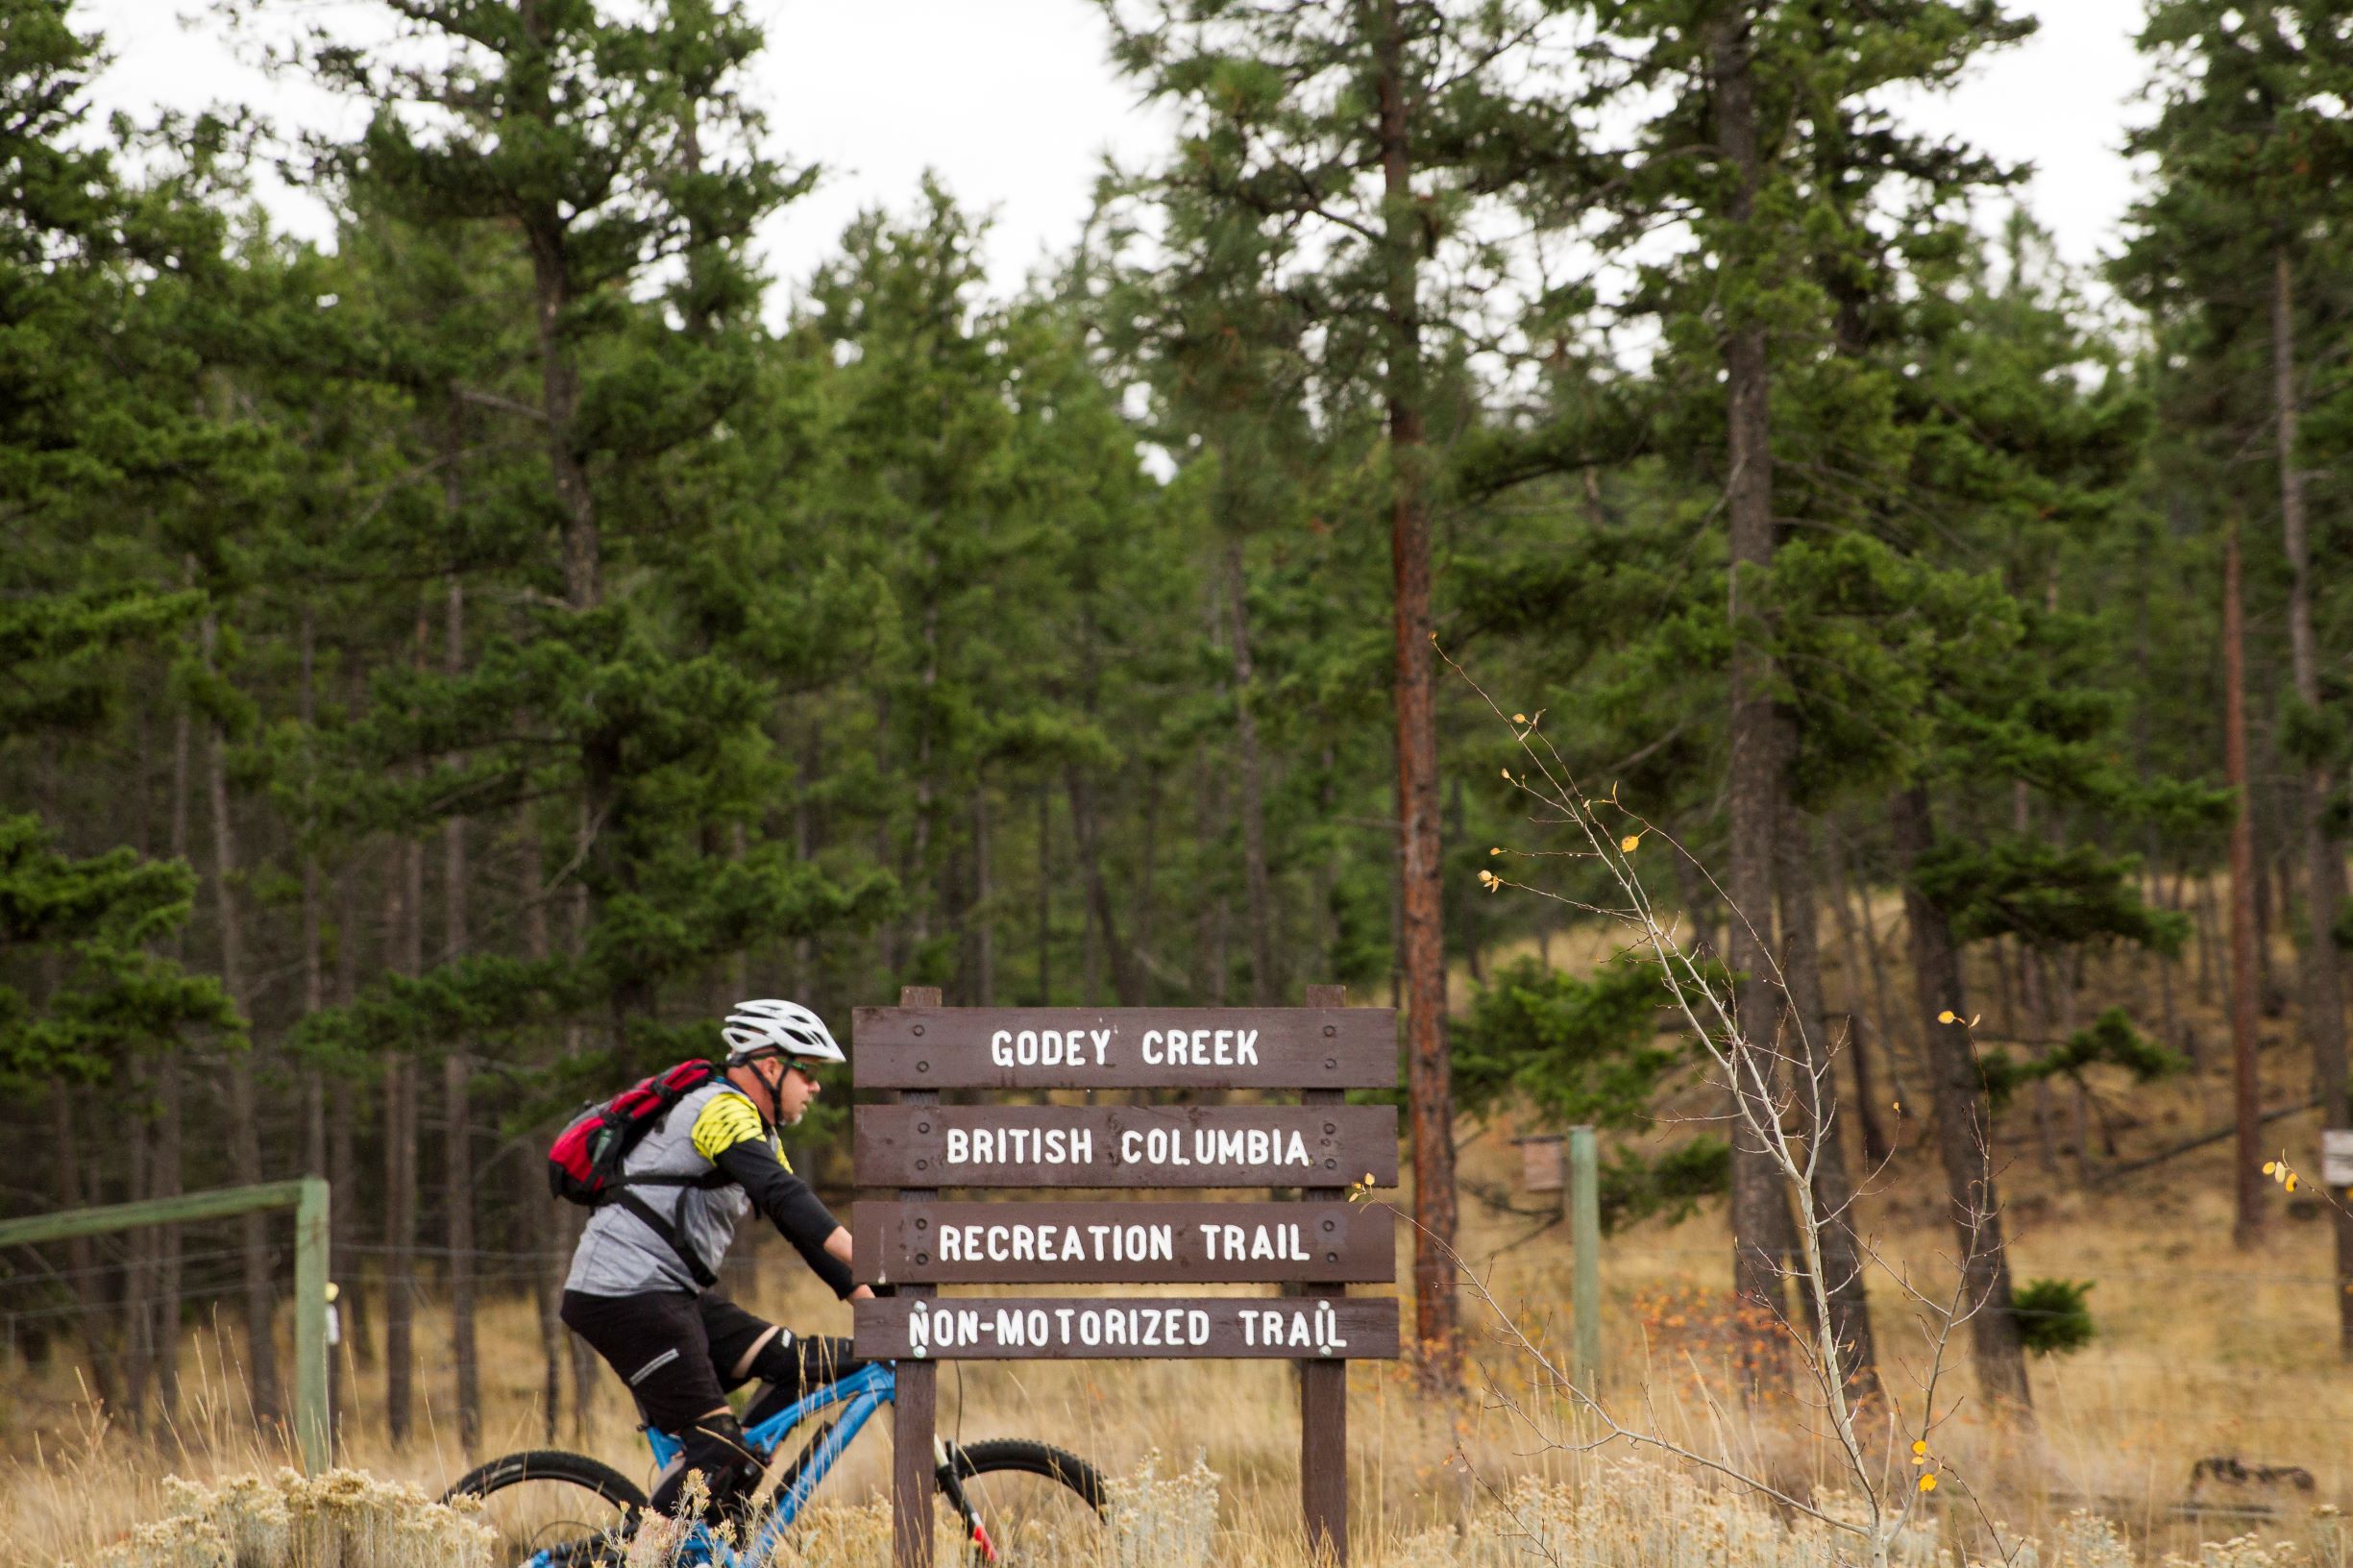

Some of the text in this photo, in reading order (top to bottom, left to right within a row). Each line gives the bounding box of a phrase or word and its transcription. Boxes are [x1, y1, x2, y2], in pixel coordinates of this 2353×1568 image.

[991, 1028, 1259, 1068] GODEY CREEK
[946, 1127, 1310, 1166] BRITISH COLUMBIA
[939, 1223, 1311, 1262] RECREATION TRAIL
[909, 1308, 1348, 1349] NON-MOTORIZED TRAIL
